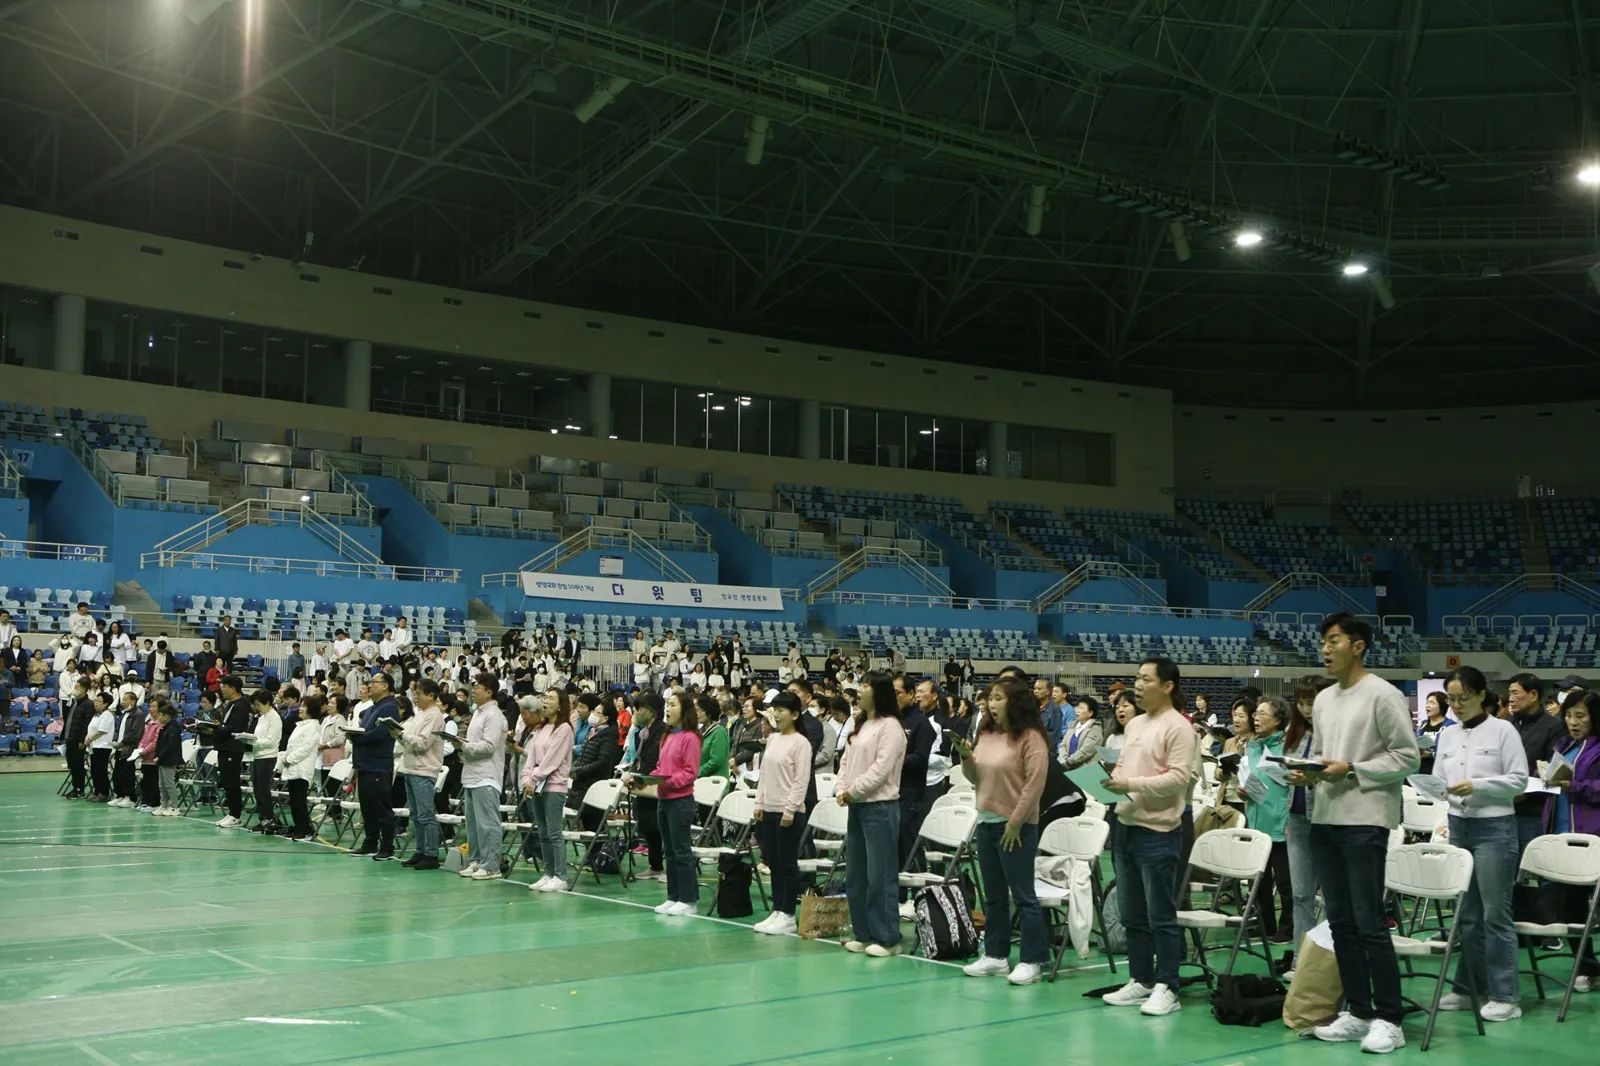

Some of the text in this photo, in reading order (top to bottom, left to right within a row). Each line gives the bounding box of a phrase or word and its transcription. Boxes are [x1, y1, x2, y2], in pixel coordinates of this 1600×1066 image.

[18, 452, 29, 463] 17
[611, 583, 625, 596] 다
[651, 585, 665, 601] 윗
[690, 588, 703, 603] 팀
[1450, 658, 1457, 666] D
